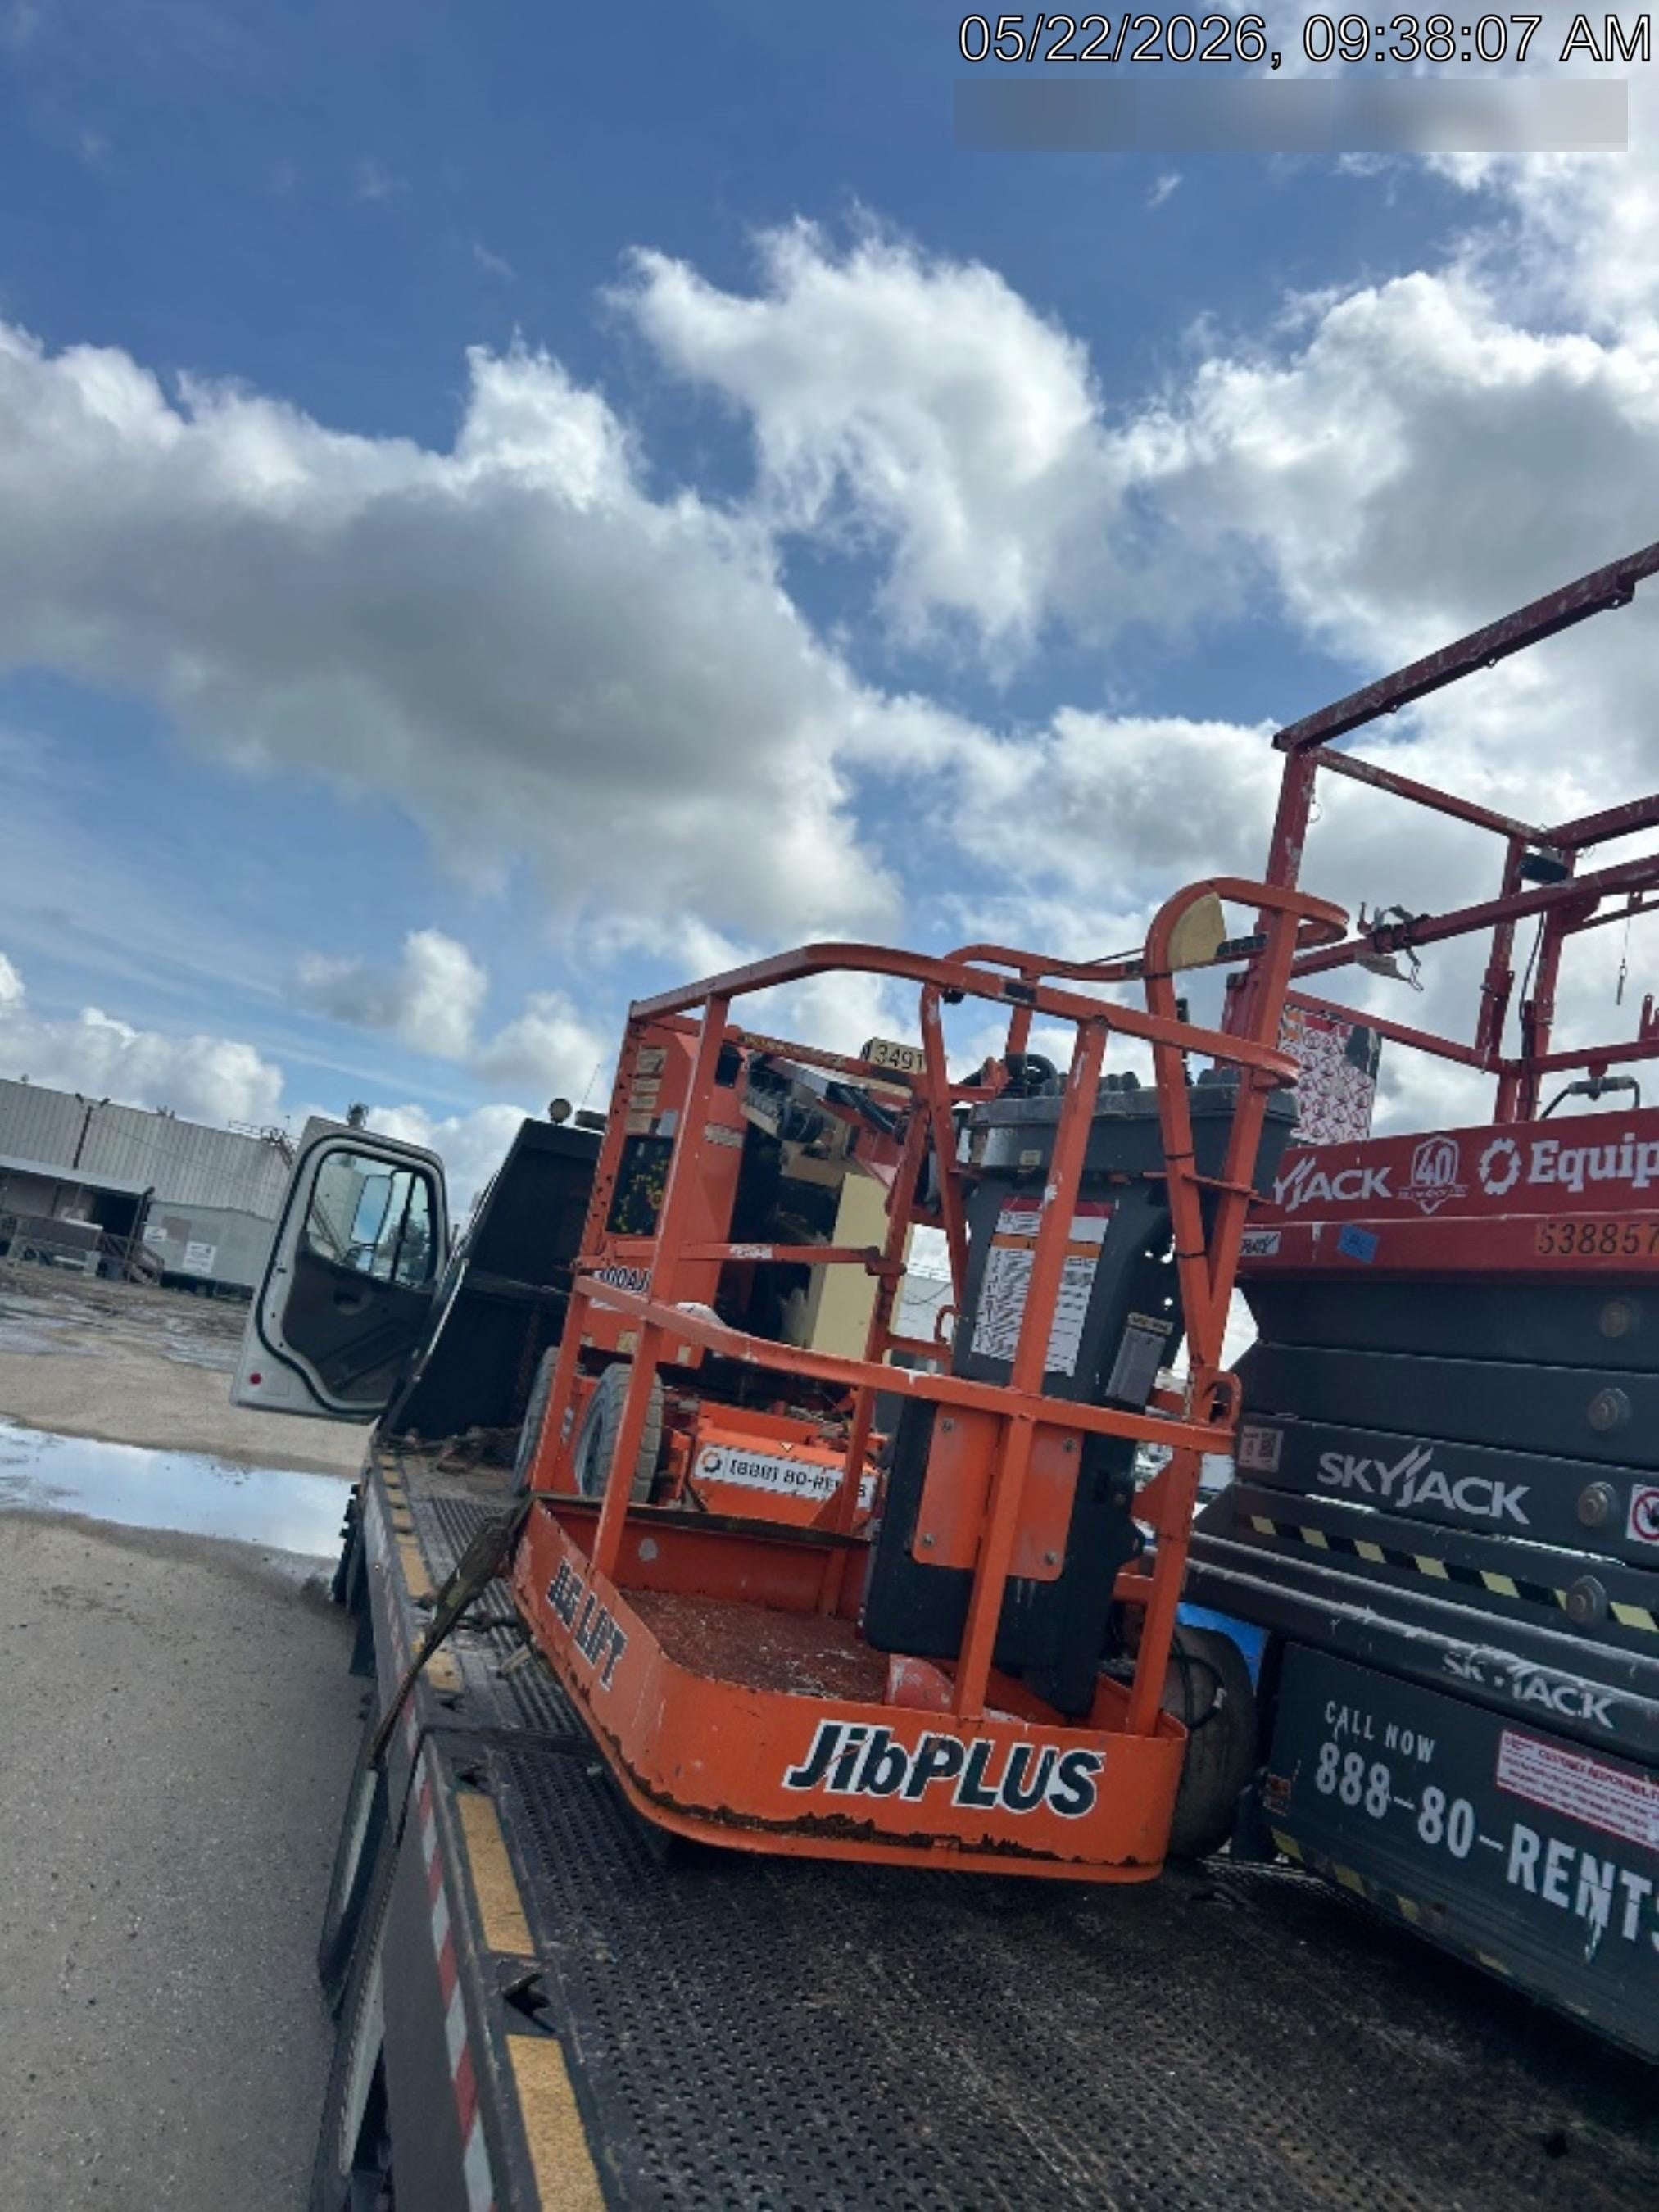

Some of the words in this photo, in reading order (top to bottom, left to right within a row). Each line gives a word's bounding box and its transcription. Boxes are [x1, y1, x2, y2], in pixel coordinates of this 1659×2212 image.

[1272, 1156, 1392, 1213] YJACK
[1415, 1146, 1453, 1186] 40
[1317, 1444, 1530, 1525] SKYJACK
[1325, 1700, 1375, 1742] CALL
[1385, 1722, 1435, 1763] NOW
[781, 1720, 1107, 1819] JibPLUS
